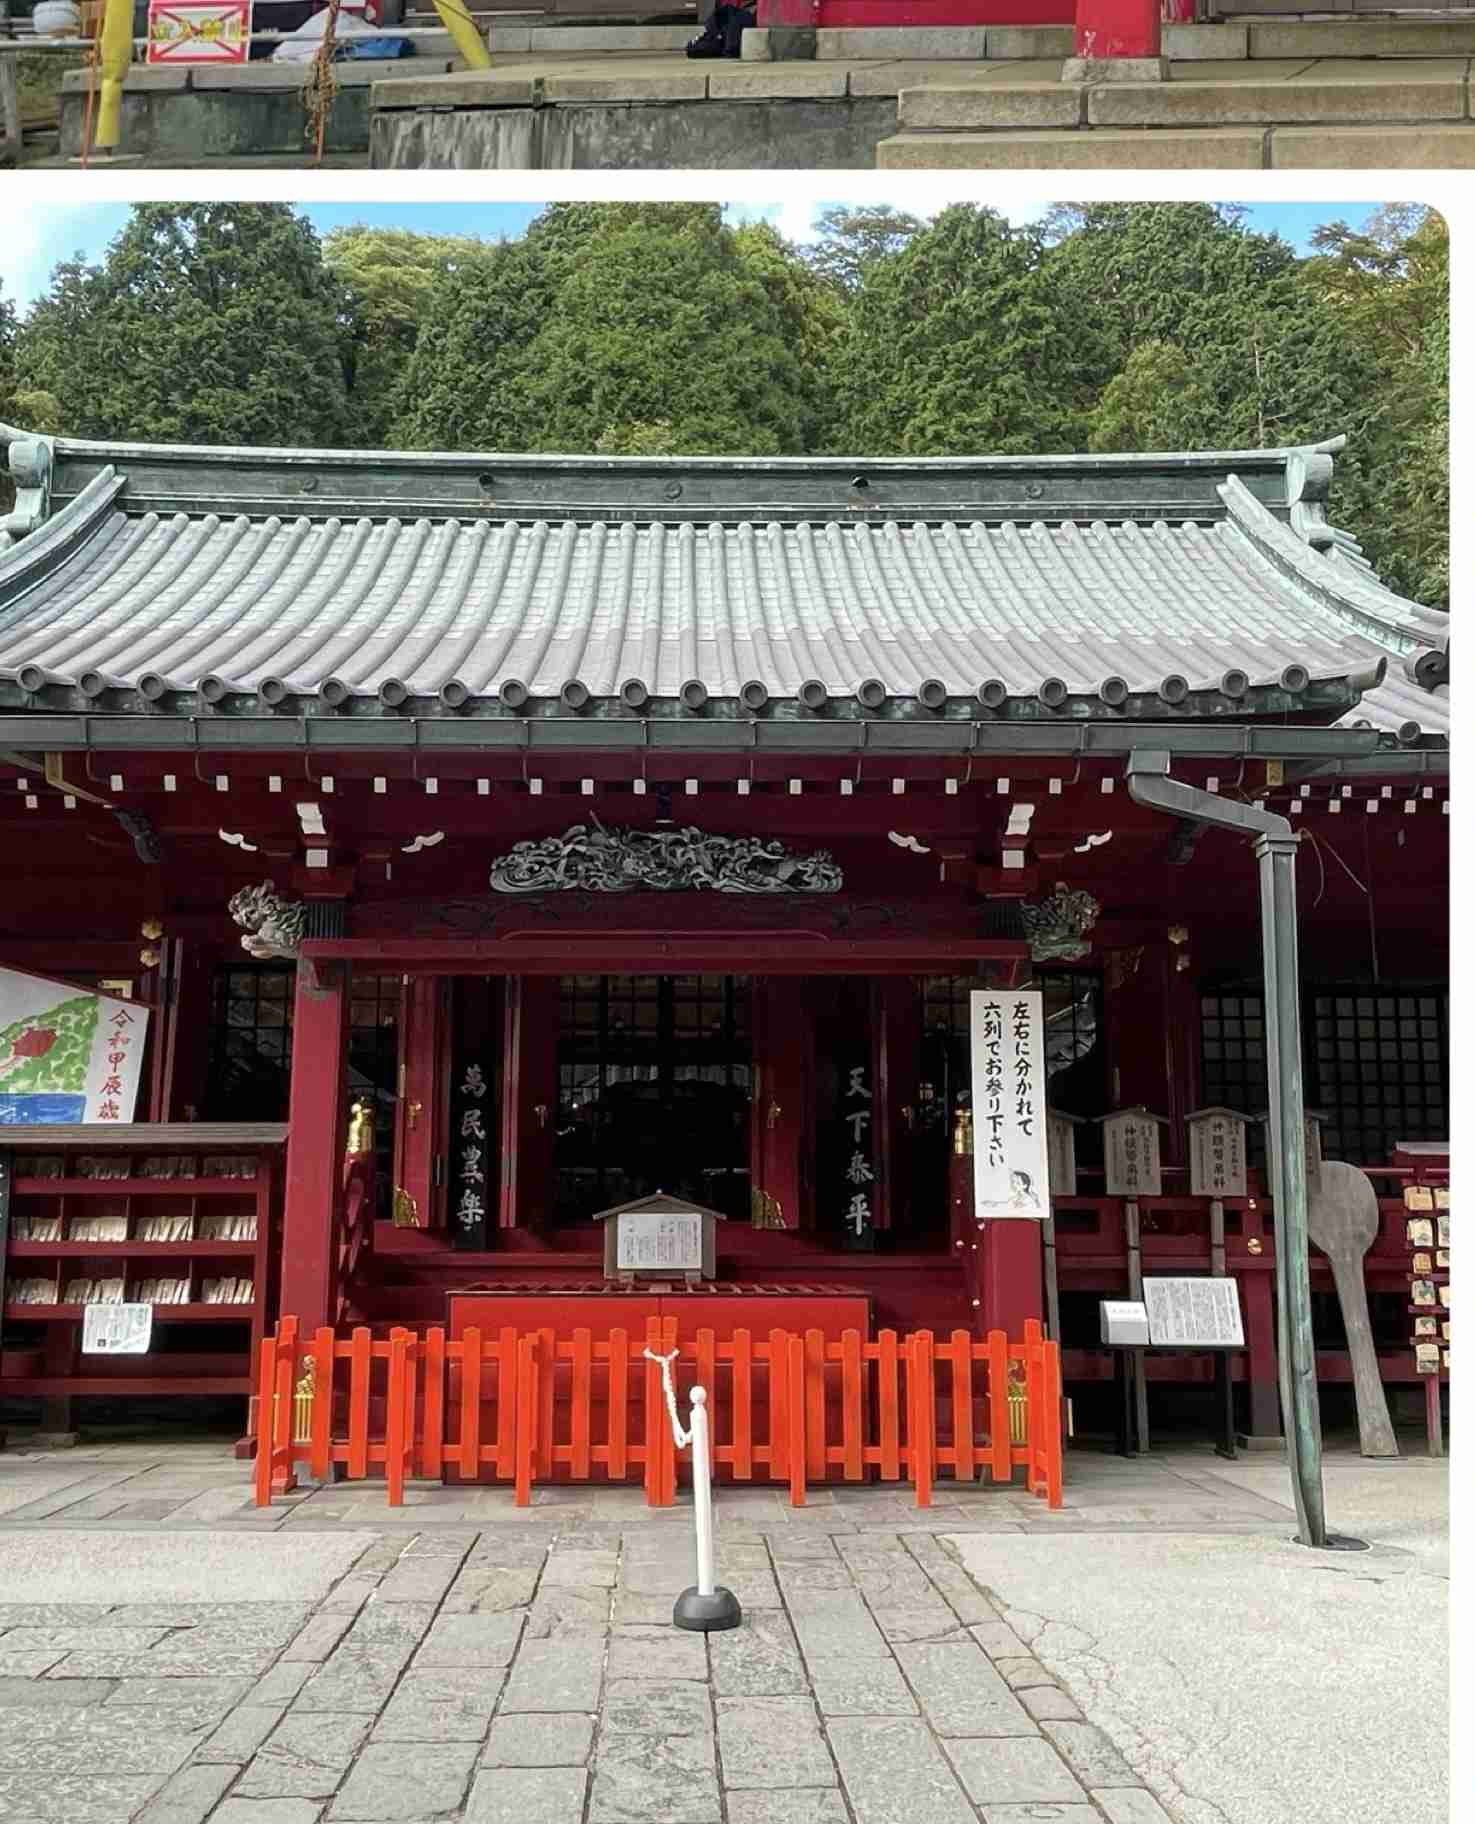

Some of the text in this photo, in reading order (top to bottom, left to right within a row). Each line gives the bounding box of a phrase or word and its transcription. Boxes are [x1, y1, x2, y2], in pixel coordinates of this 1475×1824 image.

[845, 1066, 874, 1236] 天下泰平
[984, 1001, 1005, 1167] 六列でお参り下さい
[1012, 1001, 1033, 1136] 左右に分かれて
